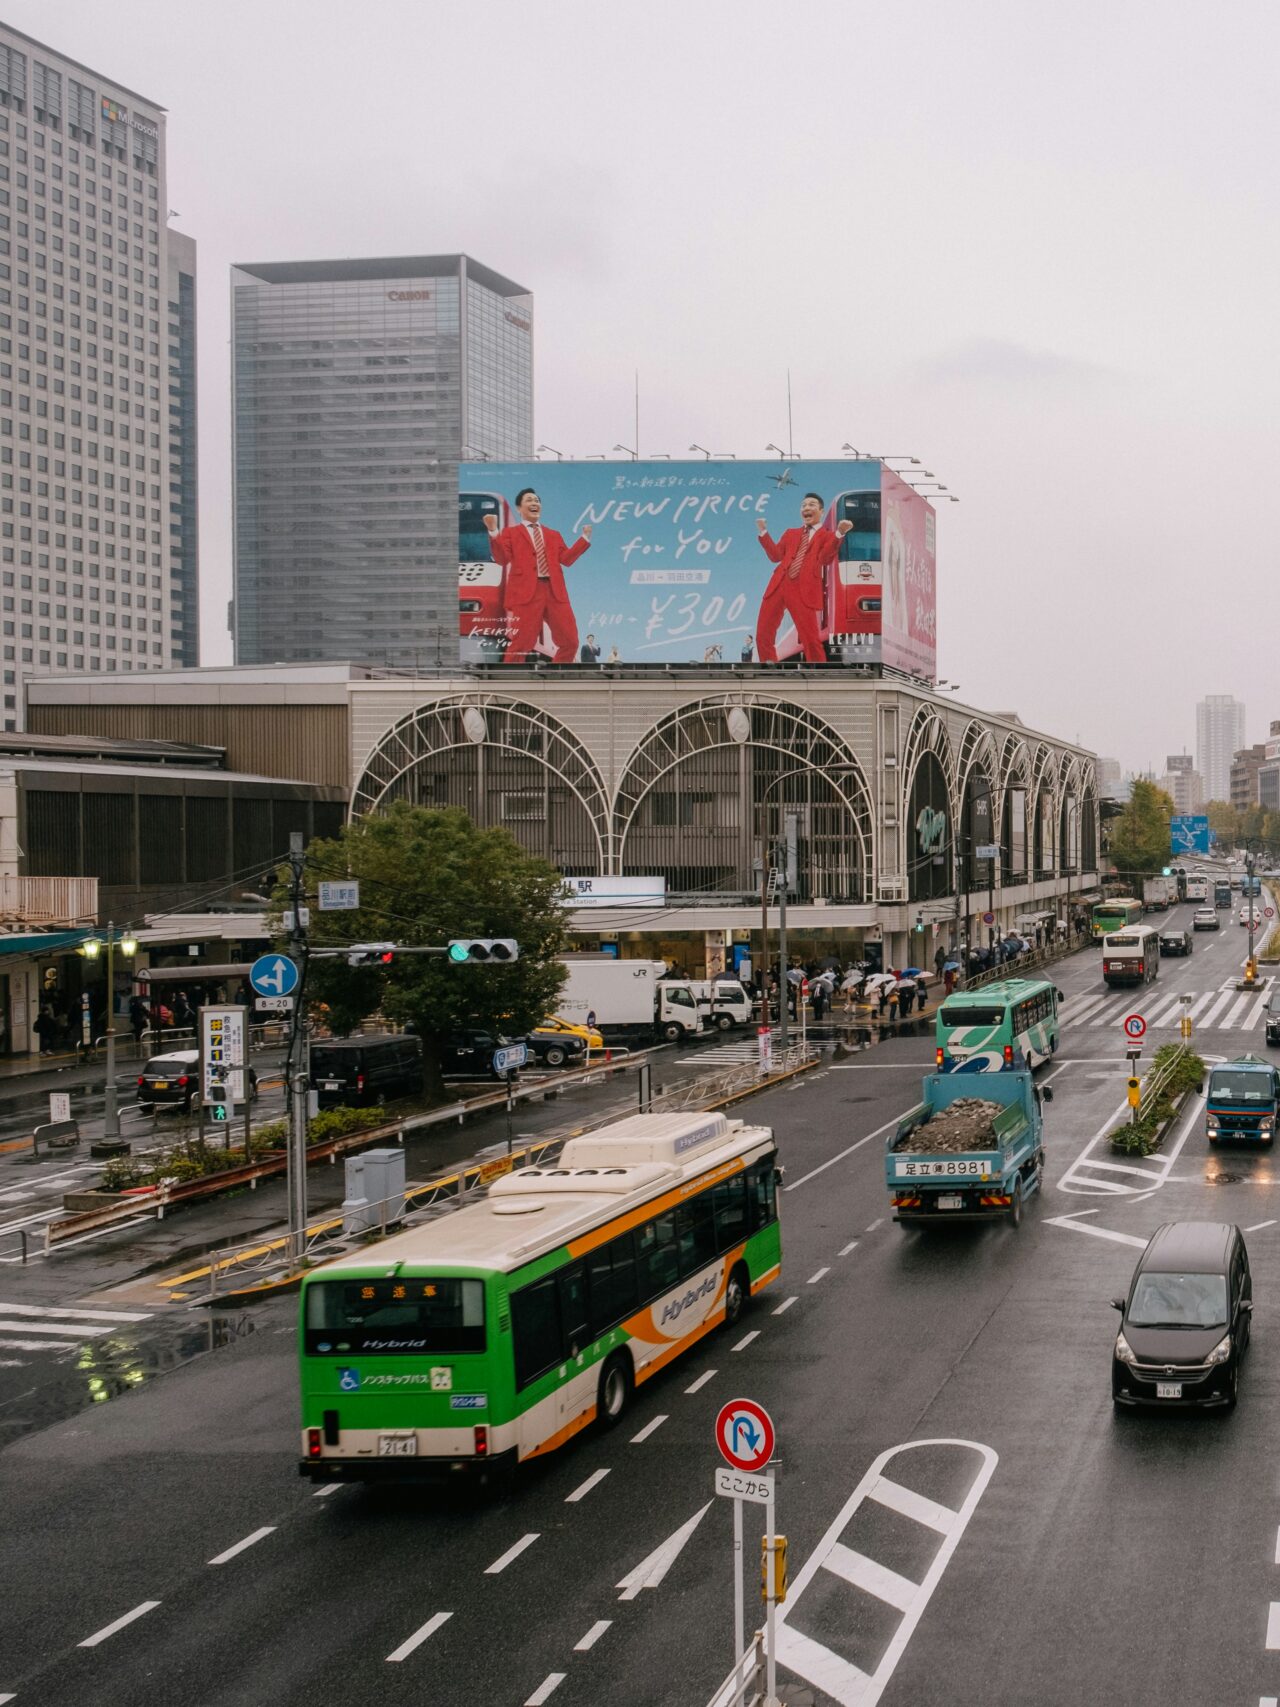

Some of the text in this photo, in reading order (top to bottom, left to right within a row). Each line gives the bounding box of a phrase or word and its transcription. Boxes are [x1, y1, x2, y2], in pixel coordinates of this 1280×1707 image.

[118, 110, 159, 138] Microsoft
[388, 290, 431, 301] Canon
[572, 493, 771, 534] NEW PRICE
[467, 626, 520, 639] KEIKYU
[829, 632, 875, 645] KEIKYU
[633, 969, 648, 977] JR
[680, 1128, 711, 1148] Hybrid
[660, 1272, 719, 1326] Hybrid
[362, 1339, 427, 1350] Hybrid
[361, 1374, 430, 1386] ノンステップバス
[720, 1475, 770, 1498] ここから
